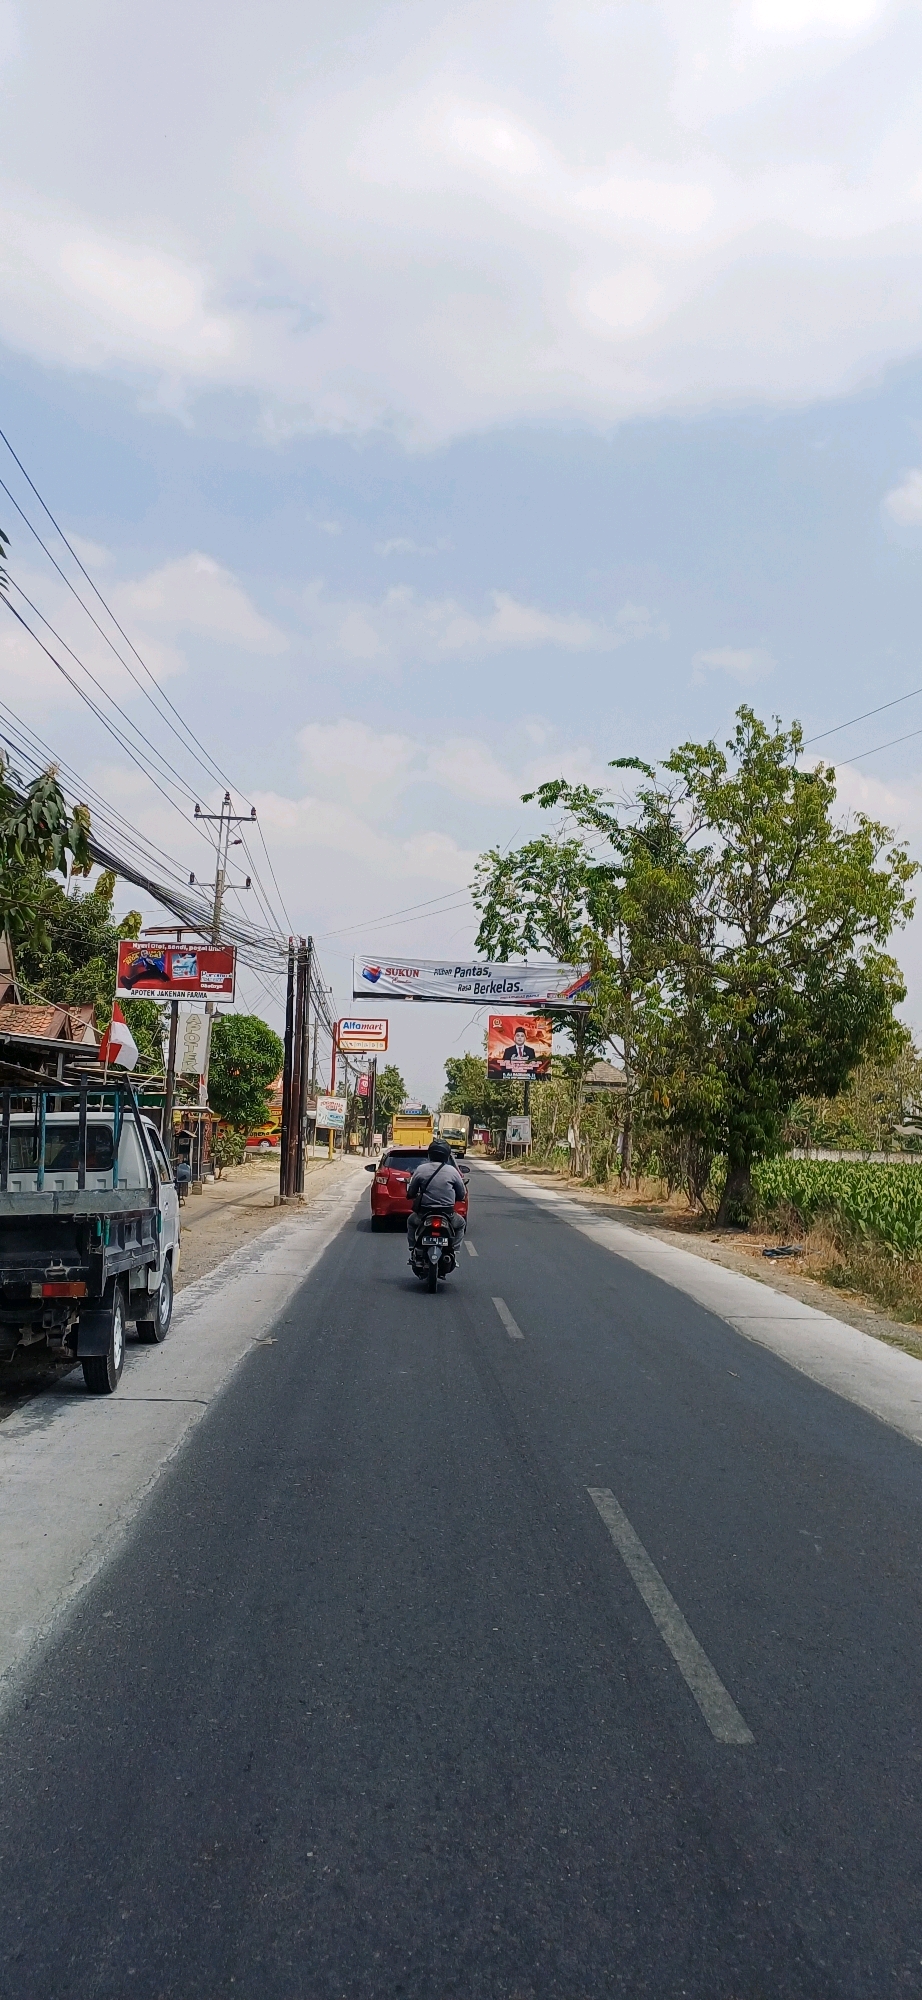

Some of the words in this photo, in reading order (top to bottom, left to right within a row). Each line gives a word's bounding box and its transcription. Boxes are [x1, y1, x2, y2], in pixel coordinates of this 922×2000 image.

[384, 967, 420, 978] SUKUN
[454, 966, 492, 978] Pantas,
[458, 983, 472, 992] Rasa
[473, 979, 524, 995] Berkelas.
[342, 1021, 383, 1031] Alfamart
[181, 1014, 202, 1072] APOTEK
